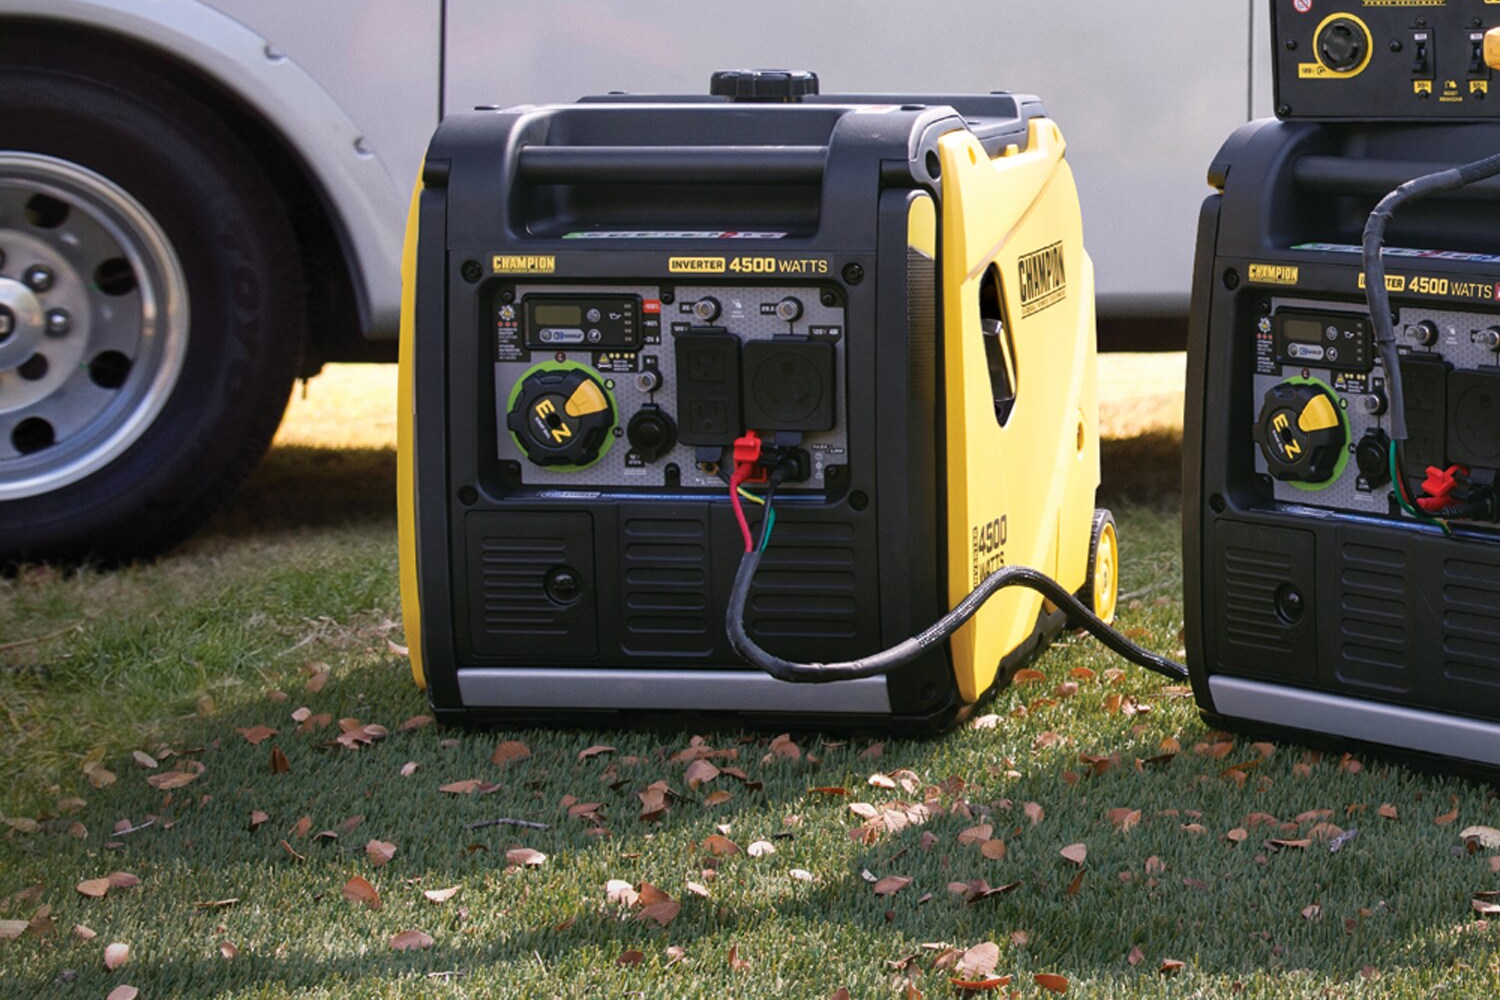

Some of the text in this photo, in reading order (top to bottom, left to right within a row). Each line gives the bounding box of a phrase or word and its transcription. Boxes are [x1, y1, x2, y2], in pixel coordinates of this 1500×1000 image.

[492, 256, 555, 270] CHAMPION
[671, 257, 829, 274] INVERTER 4500 WATTS
[1249, 263, 1298, 281] CHAMPION
[1018, 244, 1066, 303] CHAMPION
[1408, 276, 1449, 295] 4500
[1450, 281, 1492, 299] WATTS
[978, 514, 1007, 556] 4500
